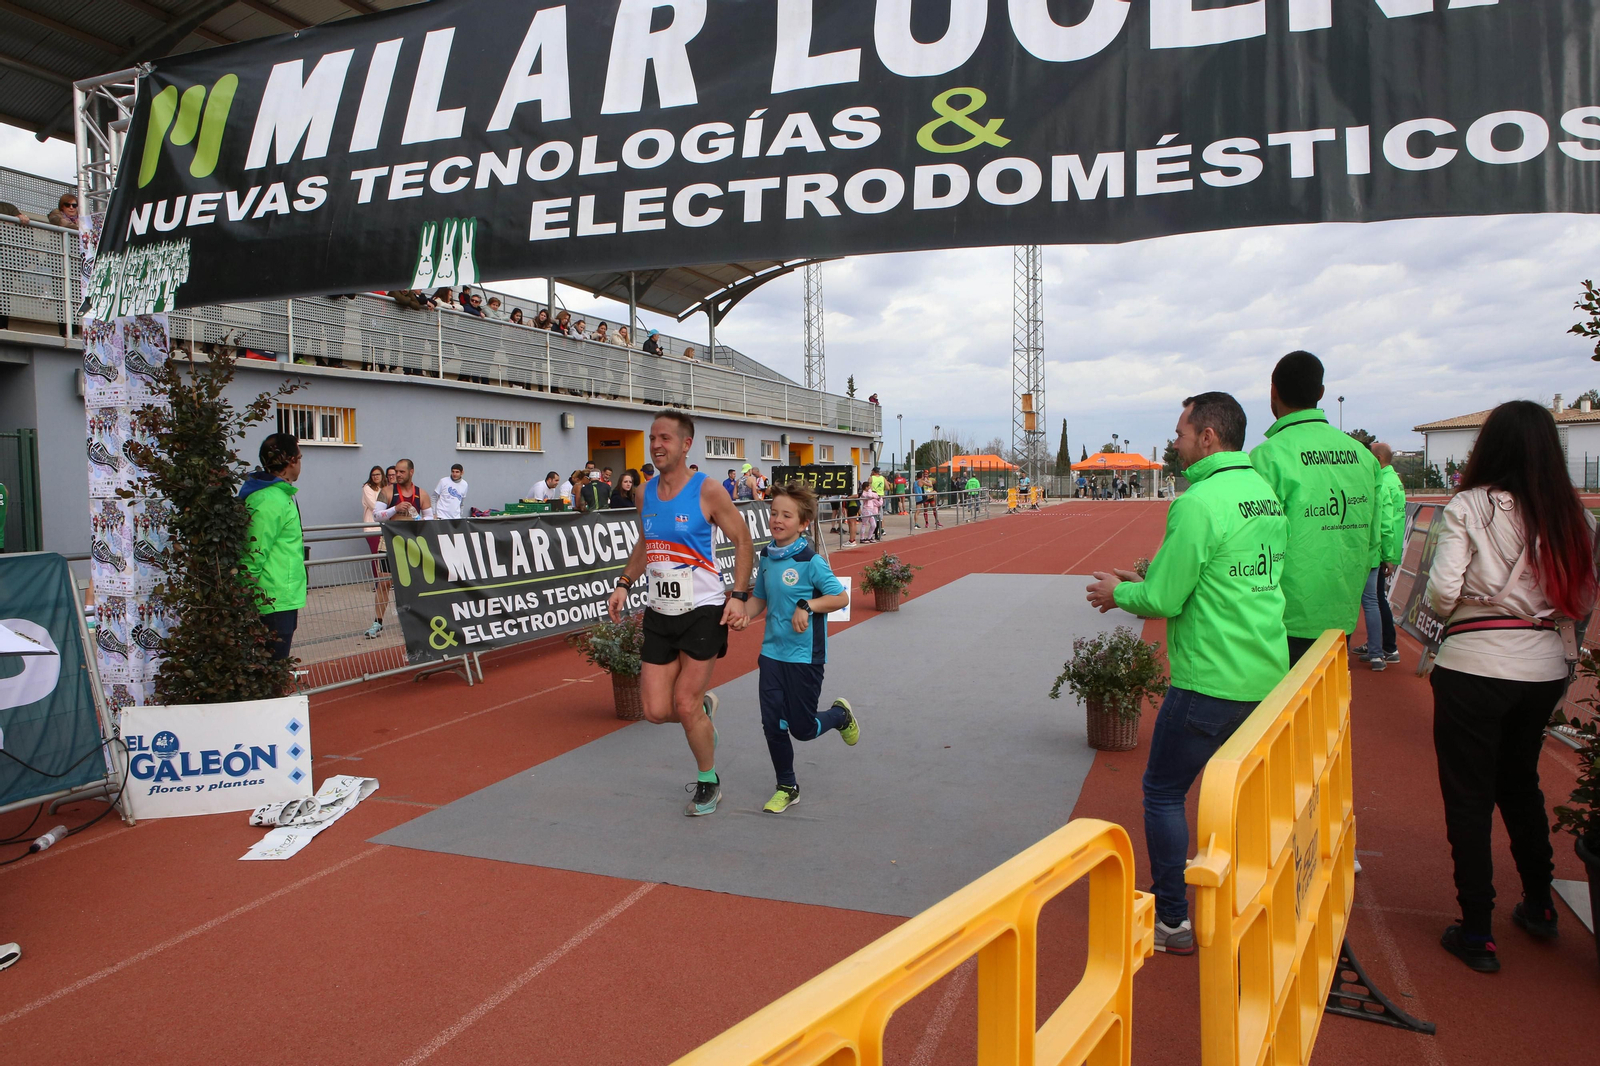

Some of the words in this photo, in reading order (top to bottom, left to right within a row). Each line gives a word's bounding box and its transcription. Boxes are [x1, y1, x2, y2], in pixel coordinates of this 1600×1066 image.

[244, 0, 707, 170] MILAR
[126, 175, 329, 242] NUEVAS
[350, 106, 881, 204] TECNOLOGÍAS
[916, 87, 1011, 154] &
[529, 105, 1600, 241] ELECTRODOMÉSTICOS
[1301, 450, 1360, 466] ORGANIZACION
[437, 528, 554, 582] MILAR
[646, 541, 671, 550] aratón
[656, 581, 680, 598] 149
[451, 592, 540, 621] NUEVAS
[428, 615, 459, 650] &
[125, 735, 150, 751] EL
[130, 743, 278, 783] GALEÓN
[148, 784, 192, 796] flores
[195, 784, 205, 792] y
[208, 777, 265, 792] plantas
